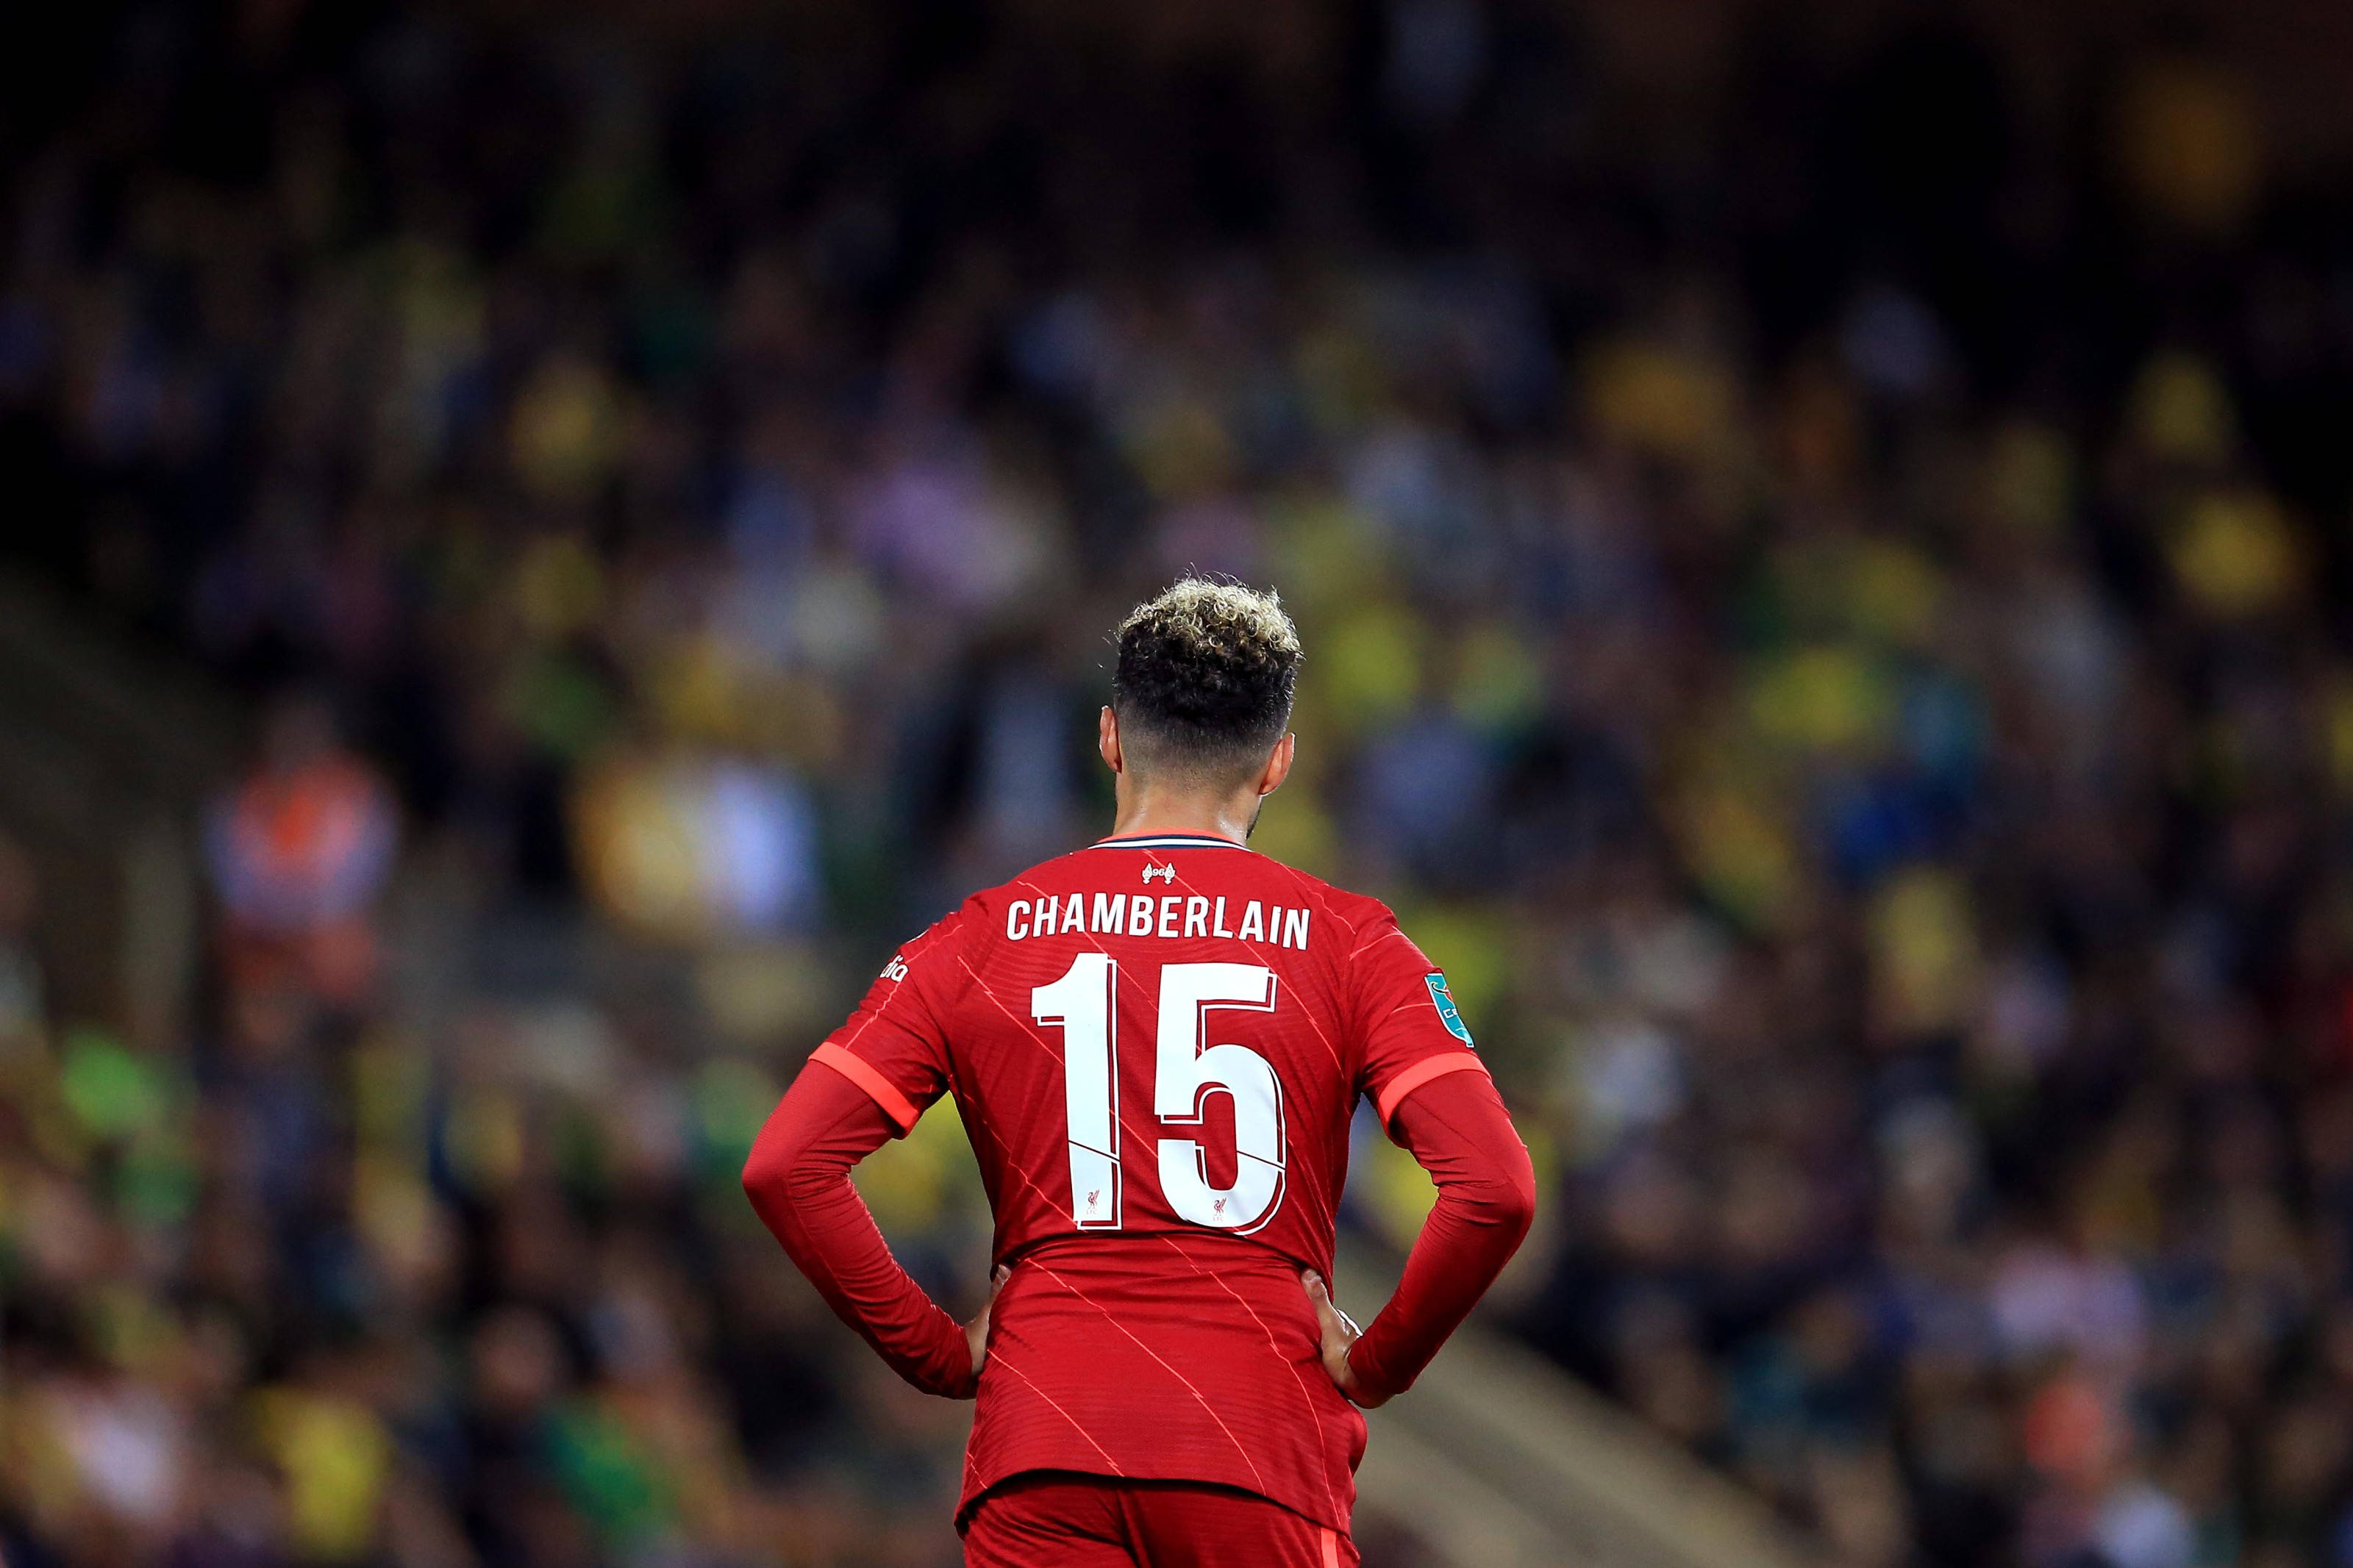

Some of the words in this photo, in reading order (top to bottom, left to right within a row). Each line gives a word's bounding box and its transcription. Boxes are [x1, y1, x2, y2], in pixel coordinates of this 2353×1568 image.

[1152, 868, 1165, 877] 96
[1007, 892, 1310, 951] CHAMBERLAIN
[1031, 952, 1287, 1236] 15
